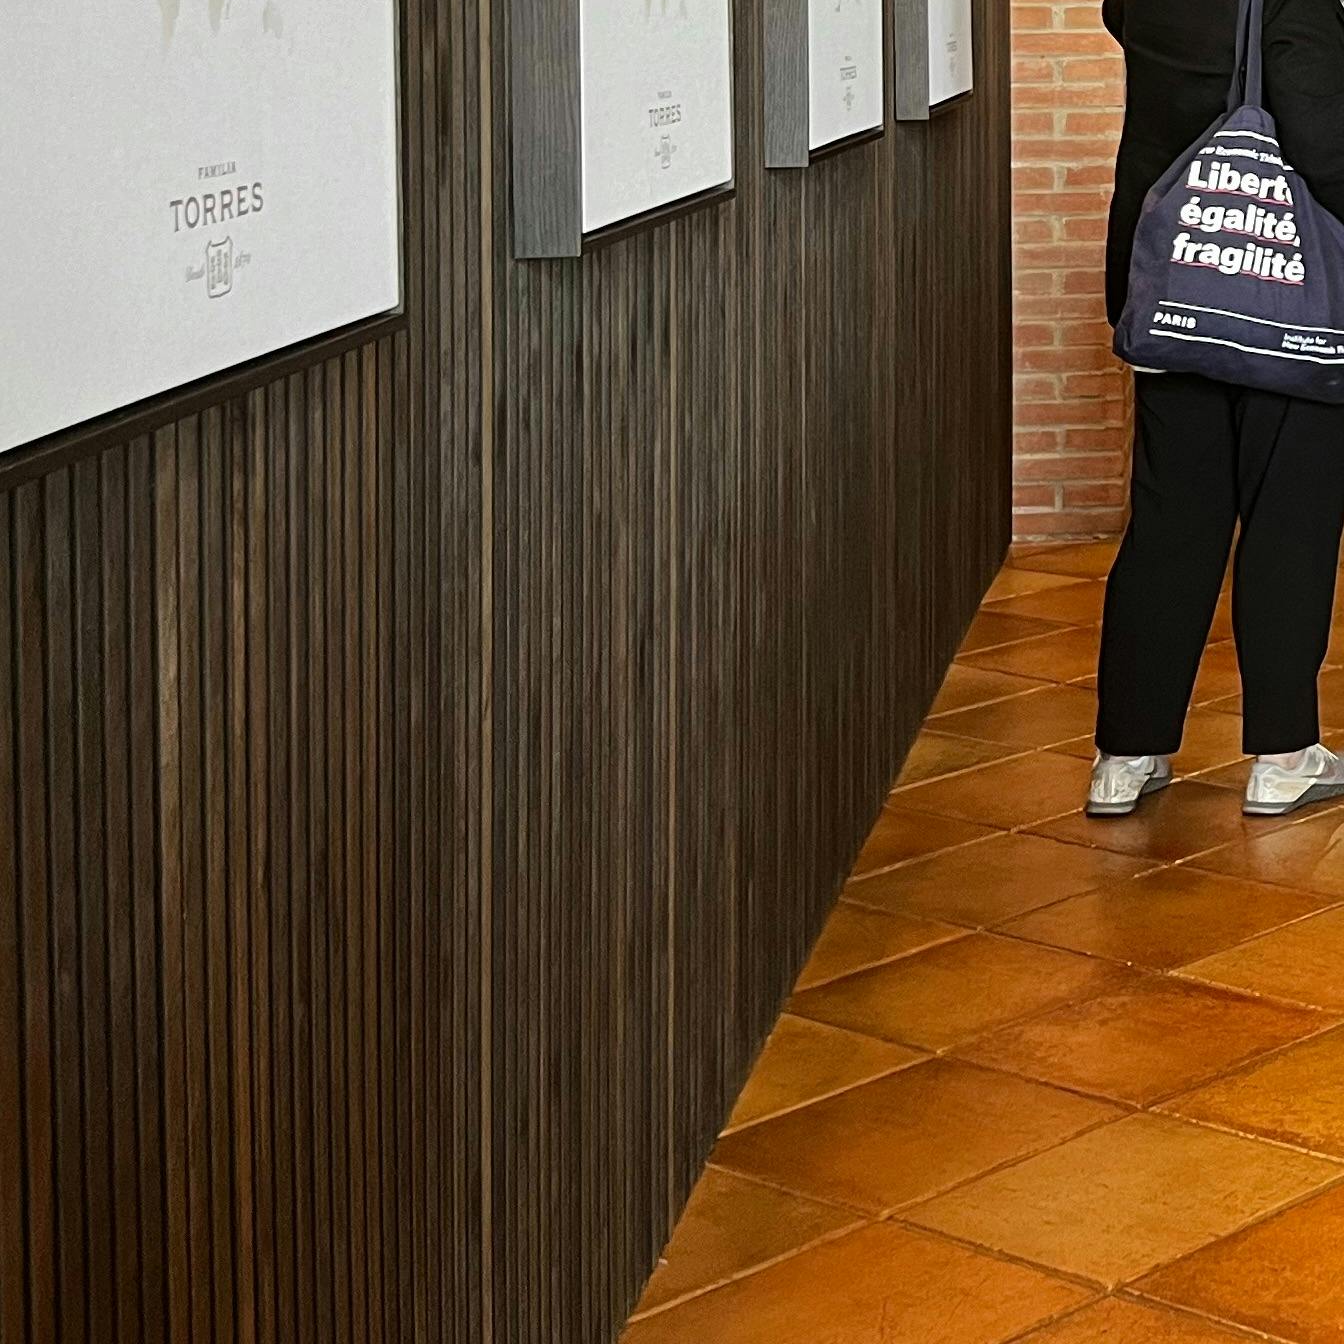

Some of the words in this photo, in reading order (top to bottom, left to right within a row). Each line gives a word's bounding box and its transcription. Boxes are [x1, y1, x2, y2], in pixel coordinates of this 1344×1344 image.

[648, 104, 682, 129] TORRES
[169, 181, 264, 233] TORRES
[1172, 232, 1306, 283] fragilité
[1153, 311, 1197, 329] PARIS
